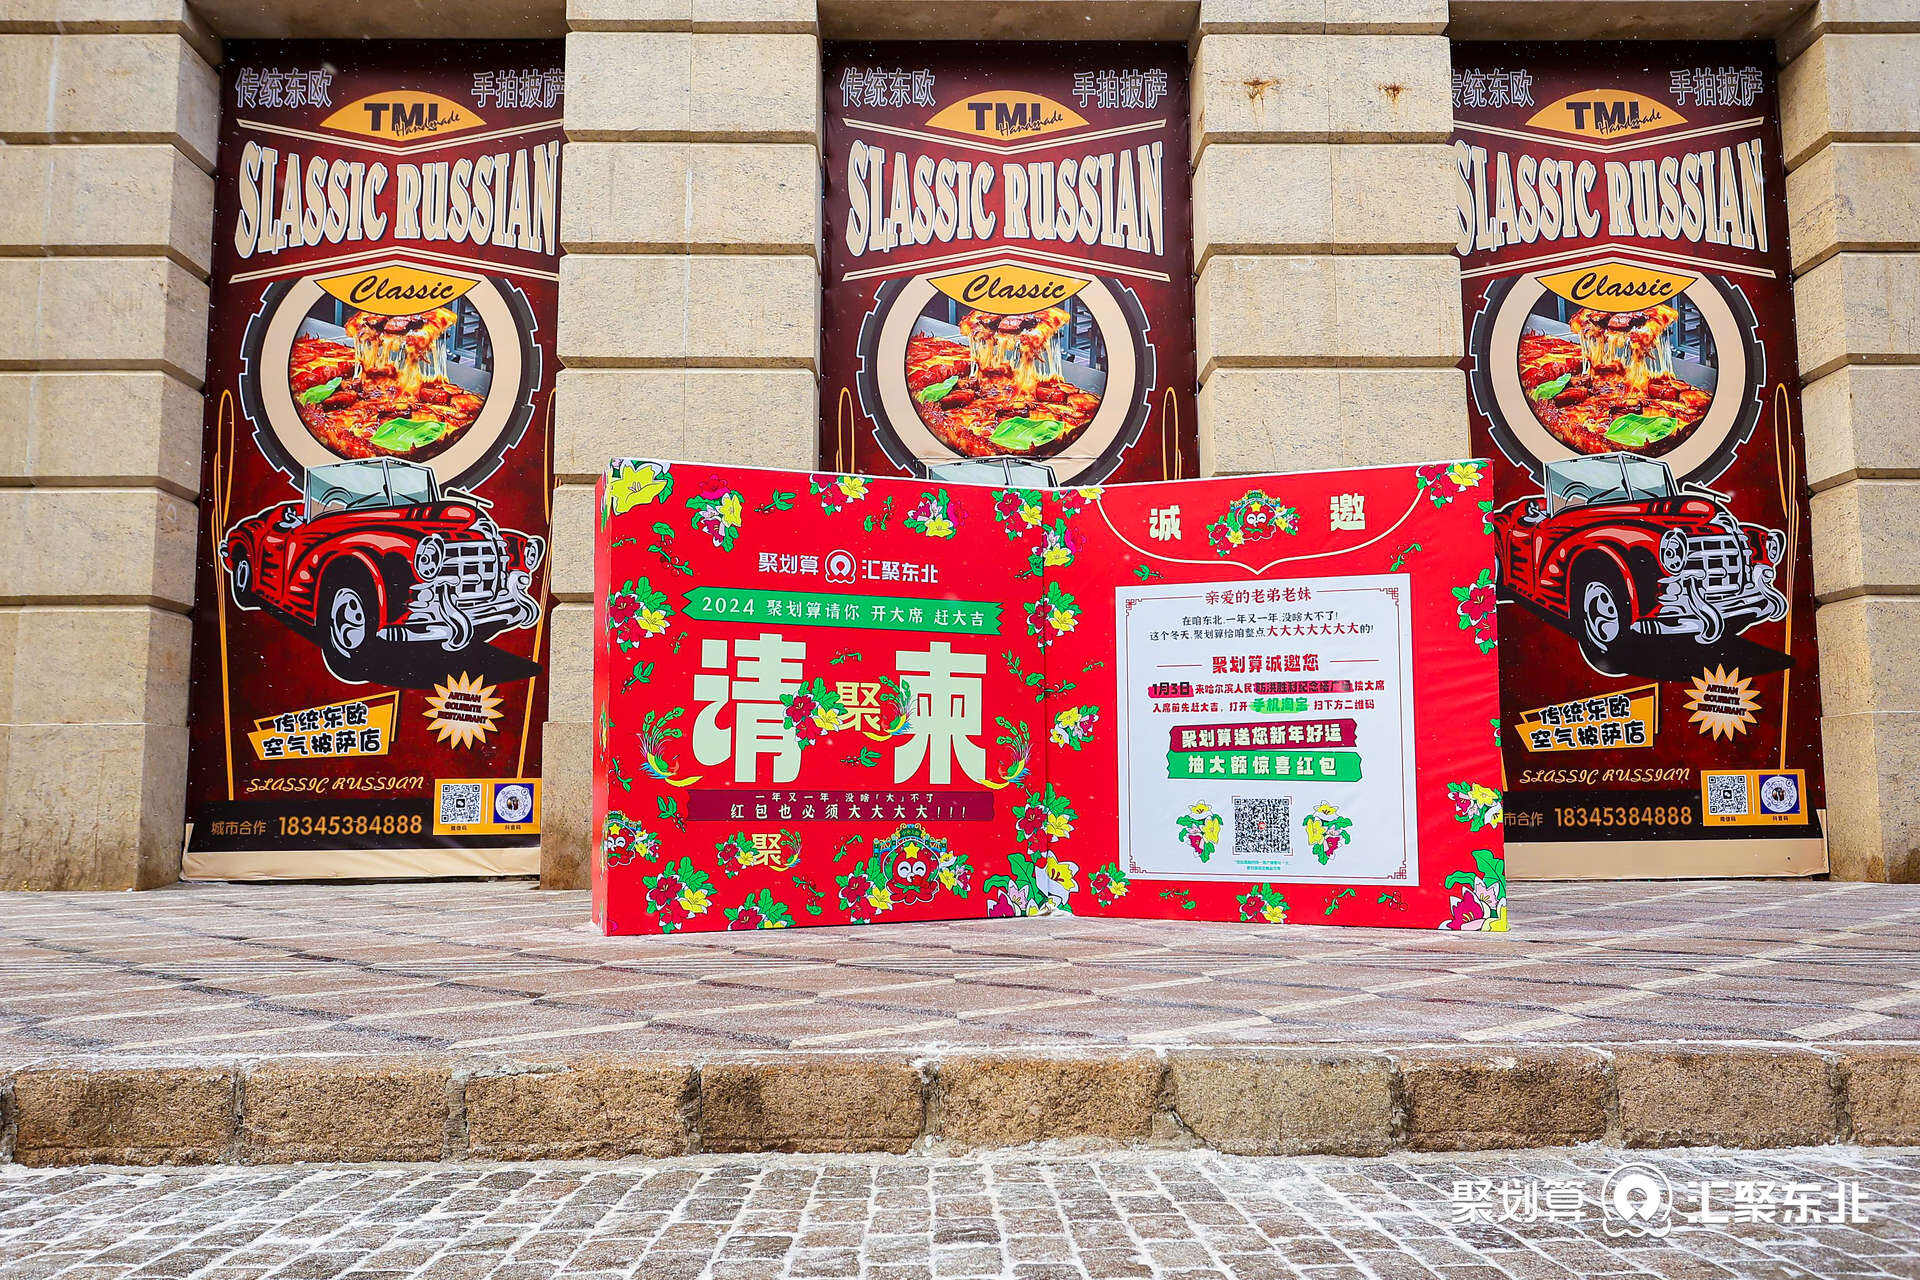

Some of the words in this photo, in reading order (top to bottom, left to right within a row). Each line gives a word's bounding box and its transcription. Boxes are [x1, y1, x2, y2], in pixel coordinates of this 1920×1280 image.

[235, 67, 333, 108] 传统东欧
[471, 68, 565, 109] 手拍披萨
[840, 67, 936, 108] 传统东欧
[1072, 68, 1168, 109] 手拍披萨
[1670, 66, 1763, 107] 手拍披萨
[395, 112, 461, 137] Handmade
[999, 112, 1063, 137] Handmade
[1598, 110, 1662, 135] Handmade
[234, 140, 388, 258] SLASSIC
[394, 140, 560, 256] RUSSIAN
[845, 139, 996, 257] SLASSIC
[1003, 141, 1164, 256] RUSSIAN
[1454, 139, 1601, 257] SLASSIC
[1605, 138, 1768, 253] RUSSIAN
[350, 275, 456, 304] Classic
[962, 274, 1067, 303] Classic
[1571, 271, 1674, 300] Classic
[1149, 504, 1182, 542] 诚
[1331, 493, 1366, 531] 邀
[758, 552, 819, 576] 聚划算
[862, 559, 938, 584] 汇聚东北
[1205, 587, 1312, 605] 亲爱的老弟老妹
[702, 596, 755, 616] 2024
[766, 599, 861, 621] 聚划算请你
[870, 607, 924, 625] 开大席
[933, 609, 985, 627] 赶大吉
[1211, 653, 1320, 674] 聚划算诚邀您
[1152, 681, 1190, 696] 1月3日
[273, 701, 370, 736] 传统东欧
[692, 633, 807, 784] 请
[834, 681, 883, 732] 聚
[1314, 698, 1375, 711] 扫下方二维码
[1539, 694, 1632, 727] 传统东欧
[261, 727, 383, 759] 空气披萨店
[1181, 723, 1342, 749] 聚划算送您新年好运
[1530, 720, 1647, 750] 空气披萨店
[1188, 755, 1338, 776] 抽大额惊喜红包
[1519, 769, 1599, 785] SLASSIC
[1602, 767, 1691, 782] RUSSIAN
[246, 778, 329, 793] SLASSIC
[332, 776, 424, 790] RUSSIAN
[211, 820, 267, 836] 城市合作
[279, 815, 423, 836] 18345384888
[1554, 806, 1693, 828] 18345384888
[751, 833, 782, 866] 聚
